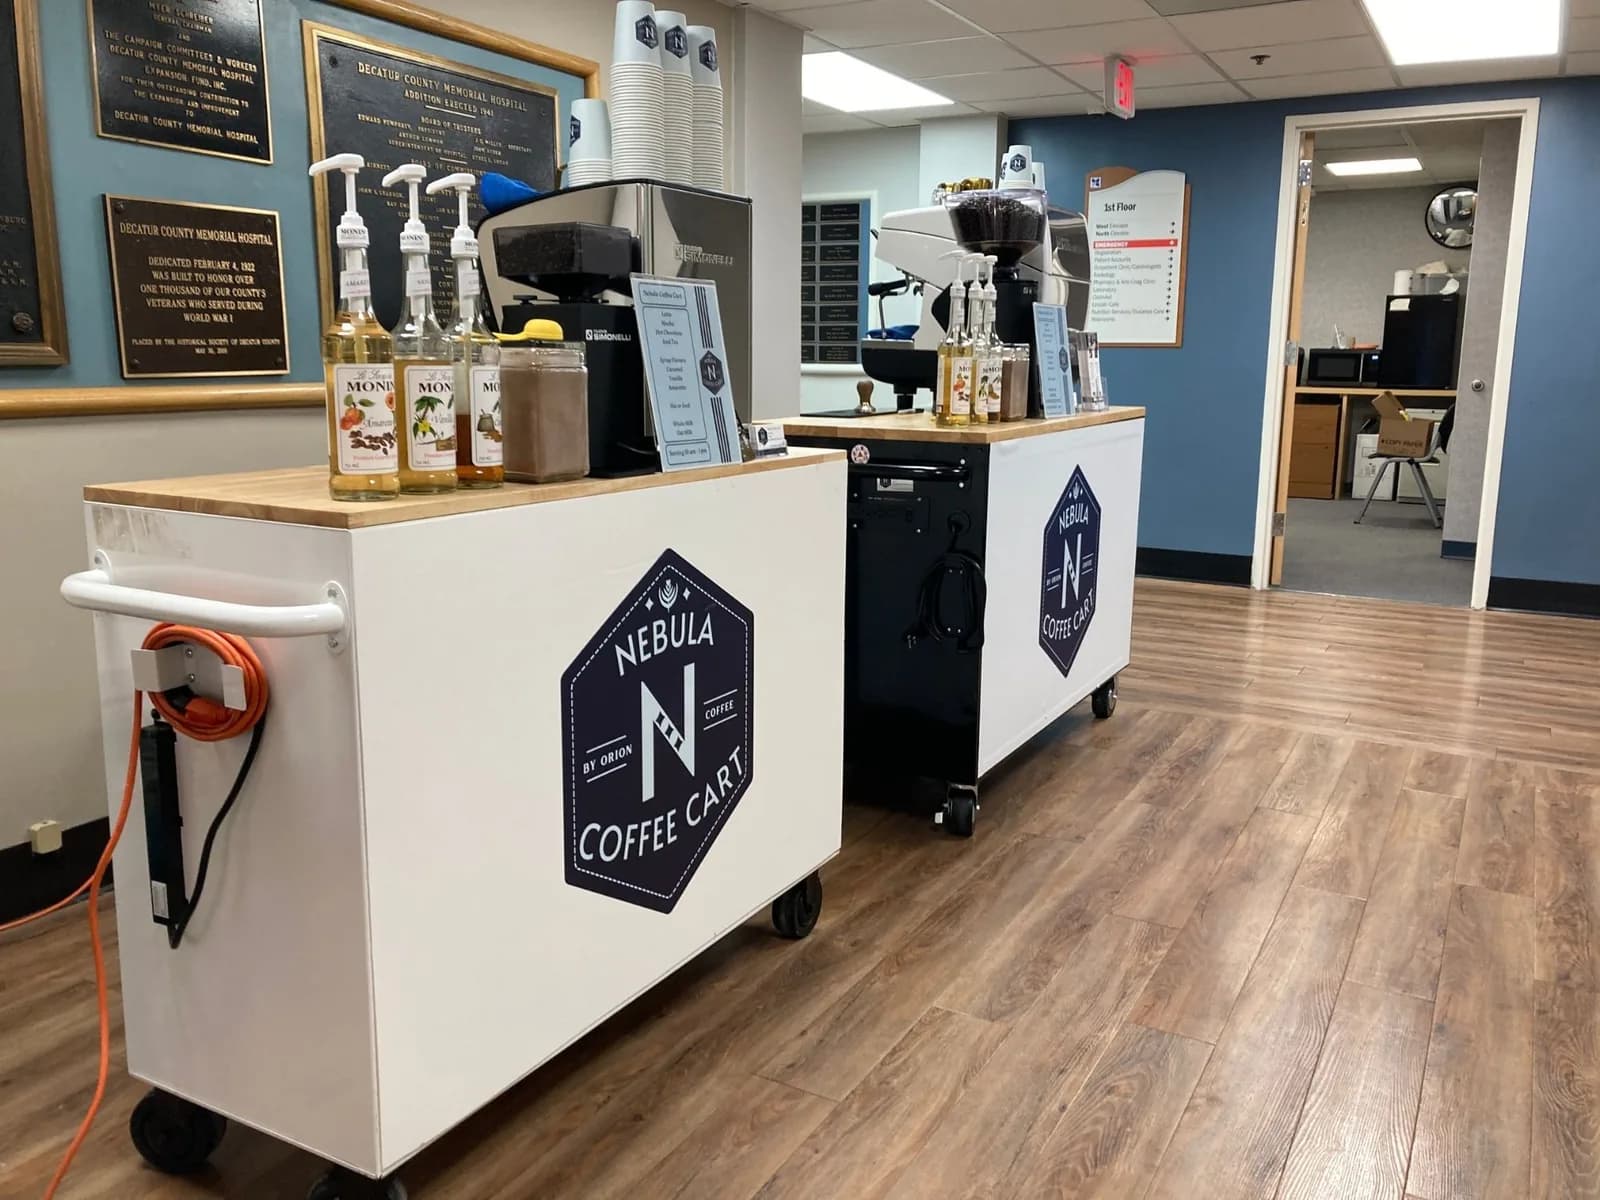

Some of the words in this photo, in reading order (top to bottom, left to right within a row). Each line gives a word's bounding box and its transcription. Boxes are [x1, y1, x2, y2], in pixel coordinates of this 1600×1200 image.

[645, 26, 655, 40] N
[674, 36, 684, 49] N
[110, 45, 145, 59] DECATUR
[148, 53, 178, 66] COUNTY
[182, 59, 218, 76] MEMORIAL
[221, 68, 254, 84] HOSPITAL
[167, 44, 213, 62] COMMITTEES
[217, 56, 223, 64] &
[226, 58, 257, 72] WORKERS
[145, 65, 188, 81] EXPANSION
[358, 62, 400, 81] DECATUR
[404, 74, 441, 90] COUNTY
[444, 83, 487, 102] MEMORIAL
[490, 95, 528, 112] HOSPITAL
[187, 101, 199, 109] AND
[404, 90, 441, 105] ADDITION
[444, 99, 478, 113] ERECTED
[114, 110, 149, 123] DECATUR
[153, 117, 182, 129] COUNTY
[186, 123, 222, 137] MEMORIAL
[226, 130, 259, 144] HOSPITAL
[1104, 203, 1115, 212] 1st
[1117, 202, 1136, 211] Floor
[120, 222, 160, 236] DECATUR
[161, 226, 194, 239] COUNTY
[196, 229, 237, 243] MEMORIAL
[238, 232, 273, 246] HOSPITAL
[149, 256, 191, 268] DEDICATED
[194, 259, 230, 270] FEBRUARY
[152, 270, 170, 280] WAS
[171, 271, 192, 282] BUILT
[195, 272, 205, 282] TO
[207, 273, 232, 284] HONOR
[235, 275, 254, 285] OVER
[140, 284, 158, 294] ONE
[160, 285, 200, 296] THOUSAND
[202, 287, 212, 296] OF
[214, 287, 230, 297] OUR
[146, 299, 186, 309] VETERANS
[189, 299, 206, 309] WHO
[208, 300, 236, 310] SERVED
[237, 301, 264, 311] DURING
[184, 313, 210, 323] WORLD
[211, 313, 228, 323] WAR
[593, 333, 632, 341] SIMONELLI
[707, 364, 717, 381] N
[1059, 503, 1089, 535] NEBULA
[1061, 533, 1082, 609] N
[1043, 614, 1072, 641] COFFEE
[1072, 588, 1094, 631] CART
[615, 612, 714, 677] NEBULA
[704, 700, 734, 720] COFFEE
[640, 662, 696, 803] N
[582, 759, 596, 775] BY
[600, 743, 633, 766] ORION
[580, 809, 678, 862] COFFEE
[685, 746, 743, 827] CART
